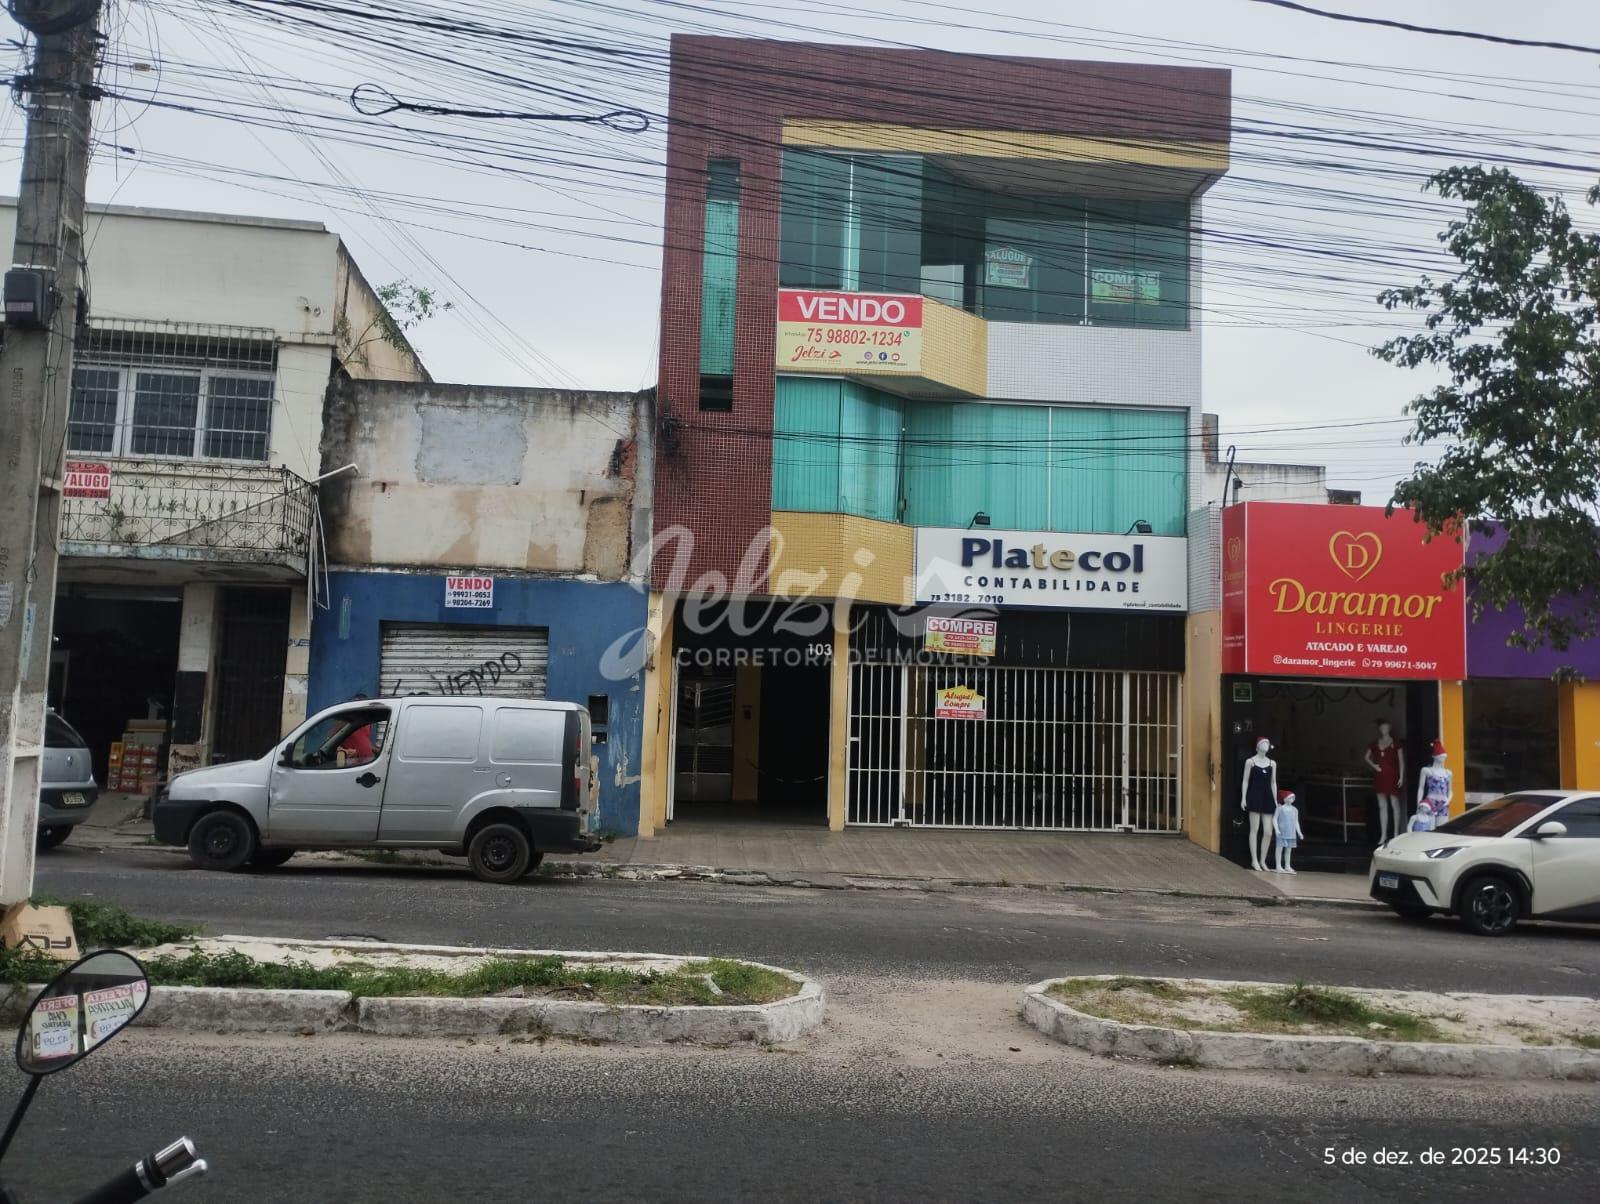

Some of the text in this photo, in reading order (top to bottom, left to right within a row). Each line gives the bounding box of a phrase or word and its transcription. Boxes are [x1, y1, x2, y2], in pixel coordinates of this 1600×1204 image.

[796, 295, 905, 324] VENDO
[807, 327, 823, 343] 75
[826, 328, 903, 346] 98802-1234
[791, 345, 827, 362] Jelzi
[961, 537, 1144, 573] Platecol
[1346, 543, 1369, 569] D
[447, 578, 492, 590] VENDO
[964, 576, 1141, 593] CONTABILIDADE
[1268, 578, 1443, 619] Daramor
[928, 619, 994, 635] COMPRE
[1316, 621, 1404, 636] LINGERIE
[807, 643, 832, 656] 103
[1305, 641, 1408, 654] ATACADO E VAREJO
[1282, 656, 1356, 668] daramor_lingerie
[1371, 660, 1382, 668] 79
